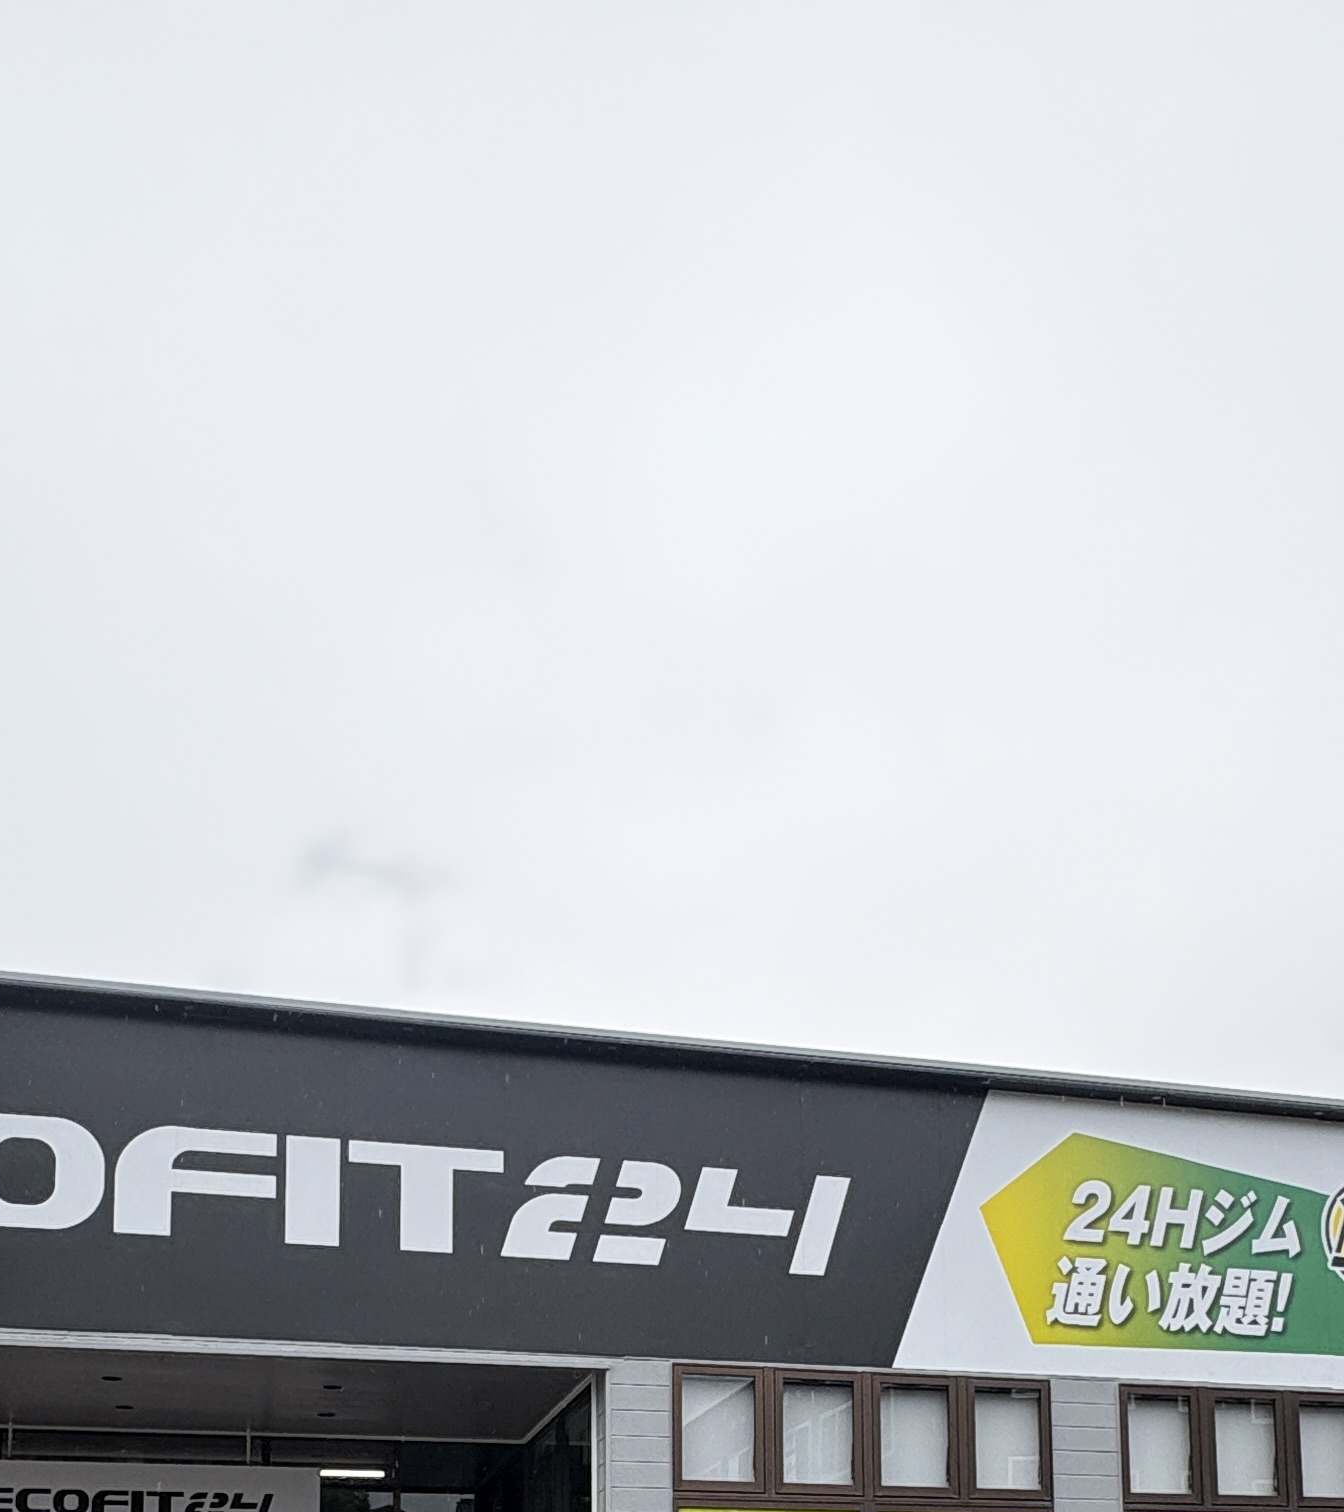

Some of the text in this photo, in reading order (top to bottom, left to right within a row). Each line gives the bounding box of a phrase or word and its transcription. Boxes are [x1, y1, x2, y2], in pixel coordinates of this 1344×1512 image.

[1063, 1180, 1301, 1258] 24Hジム
[1046, 1256, 1293, 1336] 通い放題!
